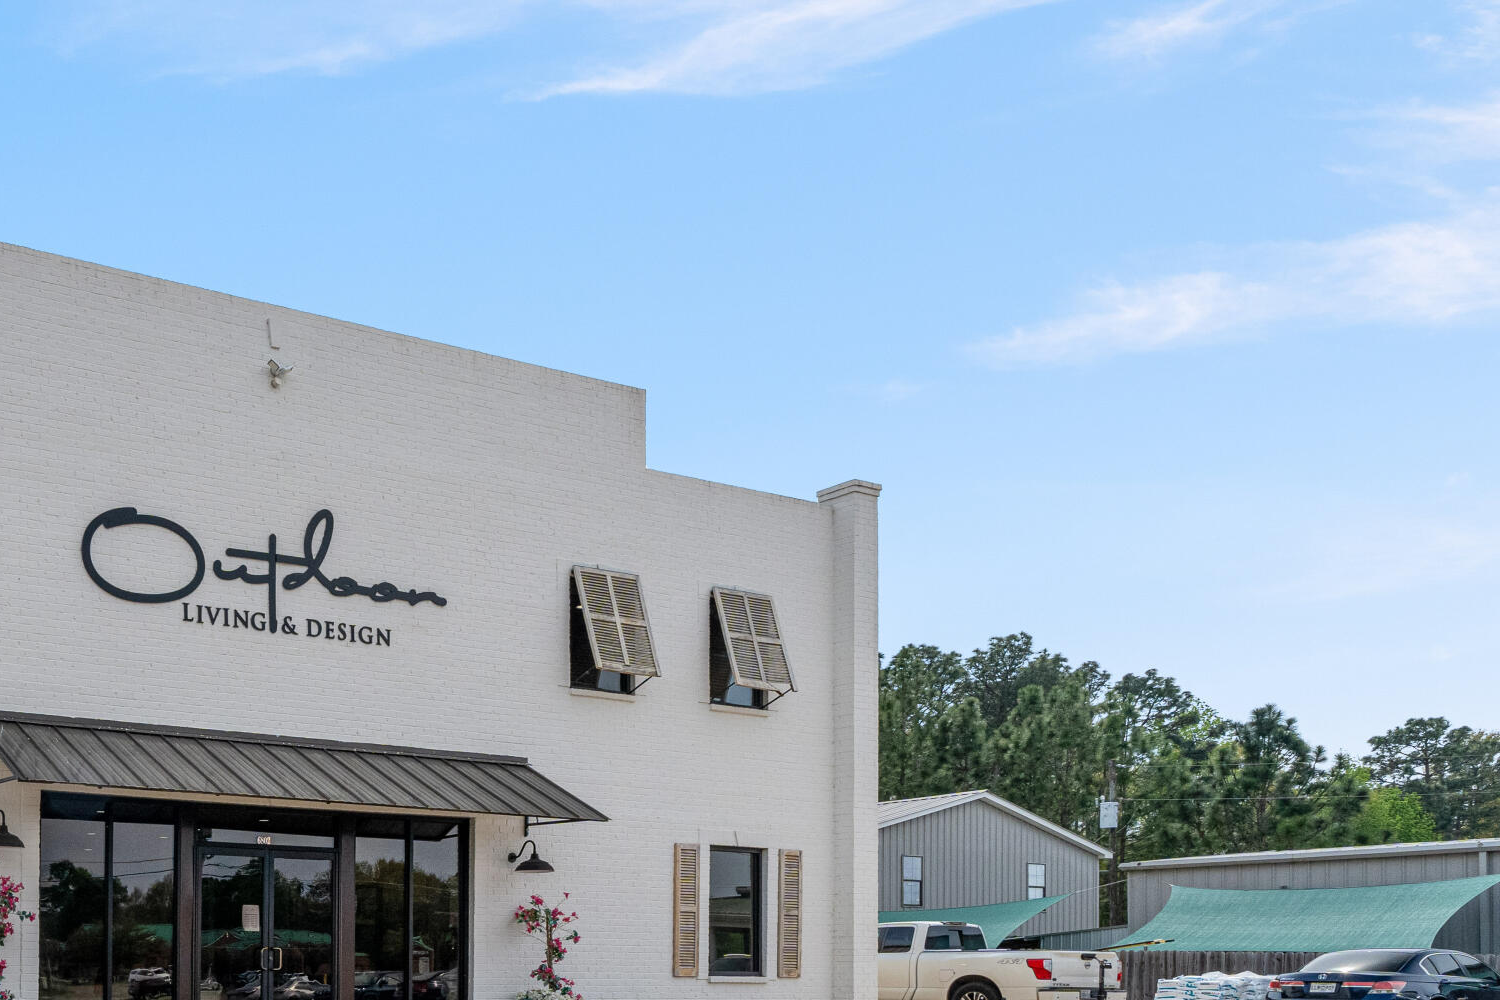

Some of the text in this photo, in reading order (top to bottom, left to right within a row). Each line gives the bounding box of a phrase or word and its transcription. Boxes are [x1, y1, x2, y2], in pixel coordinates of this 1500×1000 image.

[182, 602, 392, 647] LIVING & DESIGN
